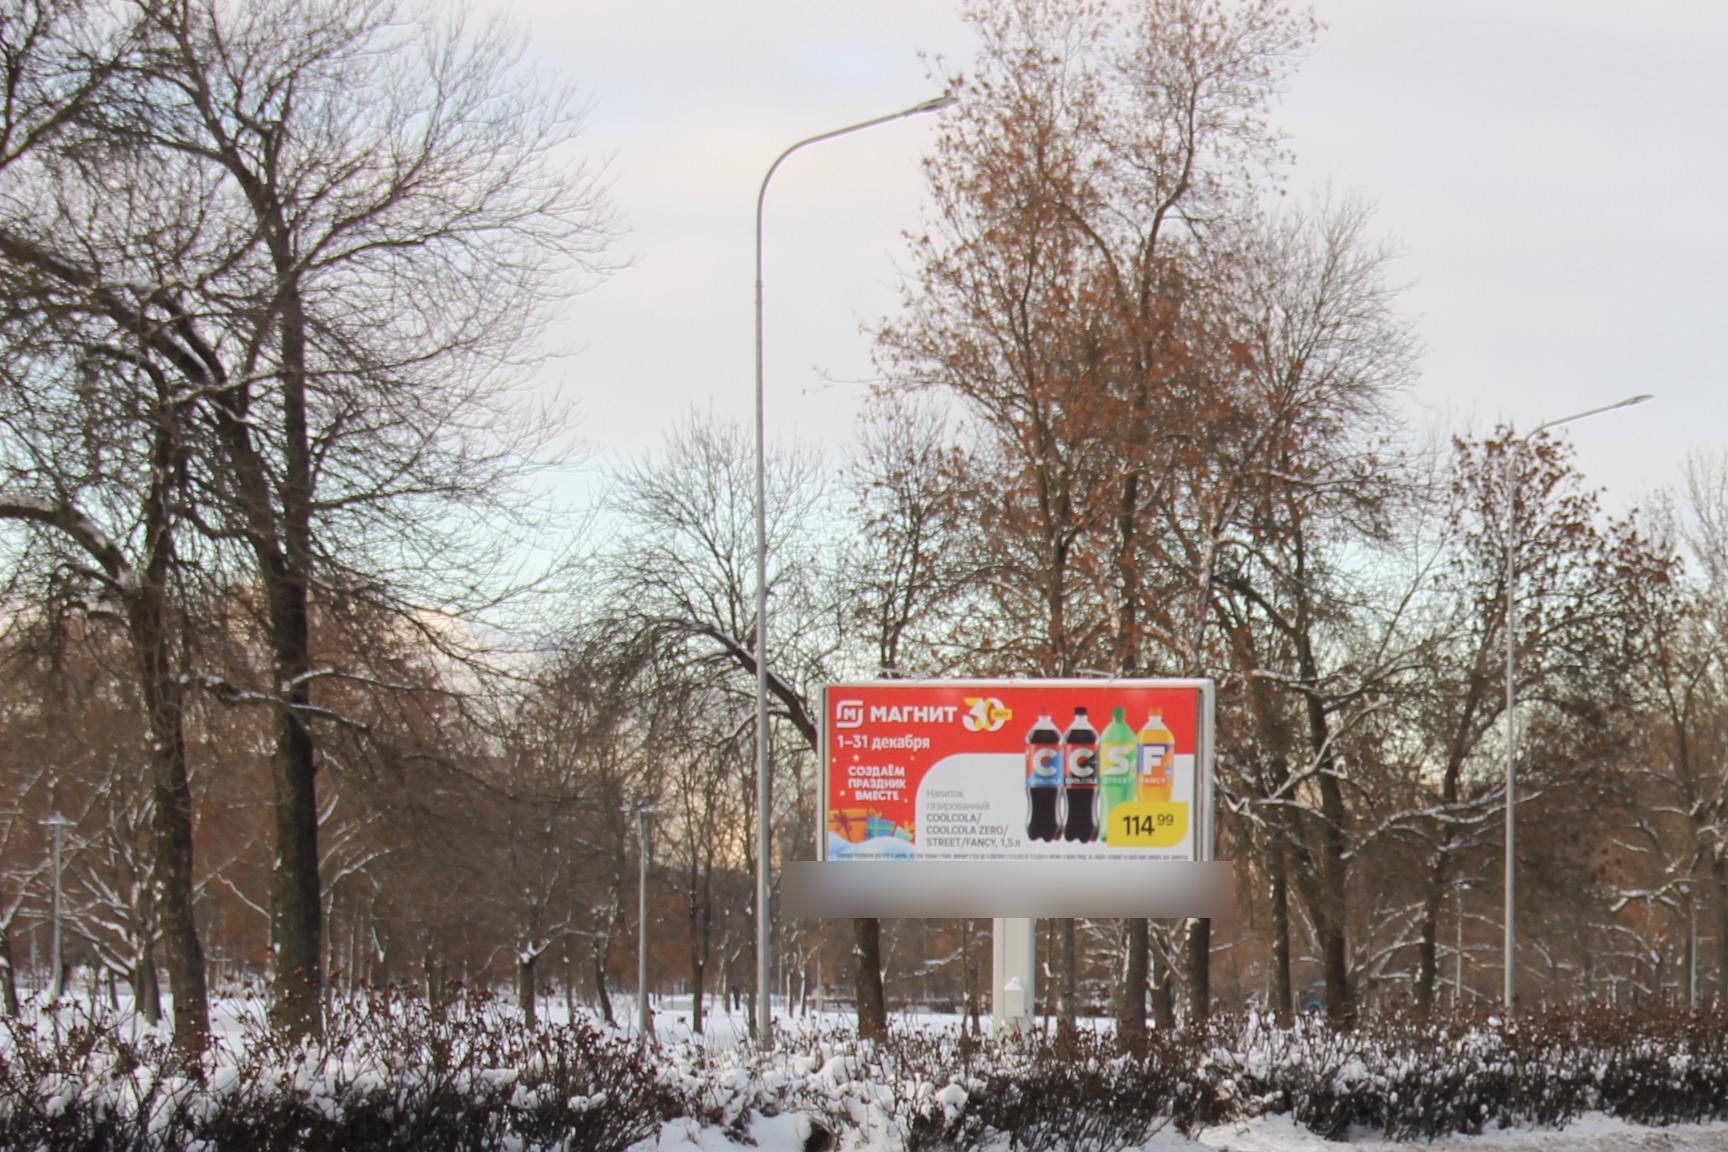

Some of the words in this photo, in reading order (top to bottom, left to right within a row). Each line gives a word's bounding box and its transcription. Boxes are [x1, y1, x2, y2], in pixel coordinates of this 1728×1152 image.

[869, 705, 958, 723] МАГНИТ
[962, 696, 1007, 732] 30
[871, 733, 931, 752] декабря
[1103, 745, 1130, 775] S
[1143, 745, 1167, 775] F
[847, 763, 906, 777] СОЗДАЁМ
[847, 777, 907, 790] ПРАЗДНИК
[854, 790, 900, 801] ВМЕСТЕ
[926, 789, 964, 799] Напиток
[926, 813, 982, 824] COOLCOLA/
[1122, 815, 1156, 836] 114
[1157, 814, 1175, 826] 99
[926, 825, 977, 836] COOLCOLA
[979, 825, 1009, 836] ZERO/
